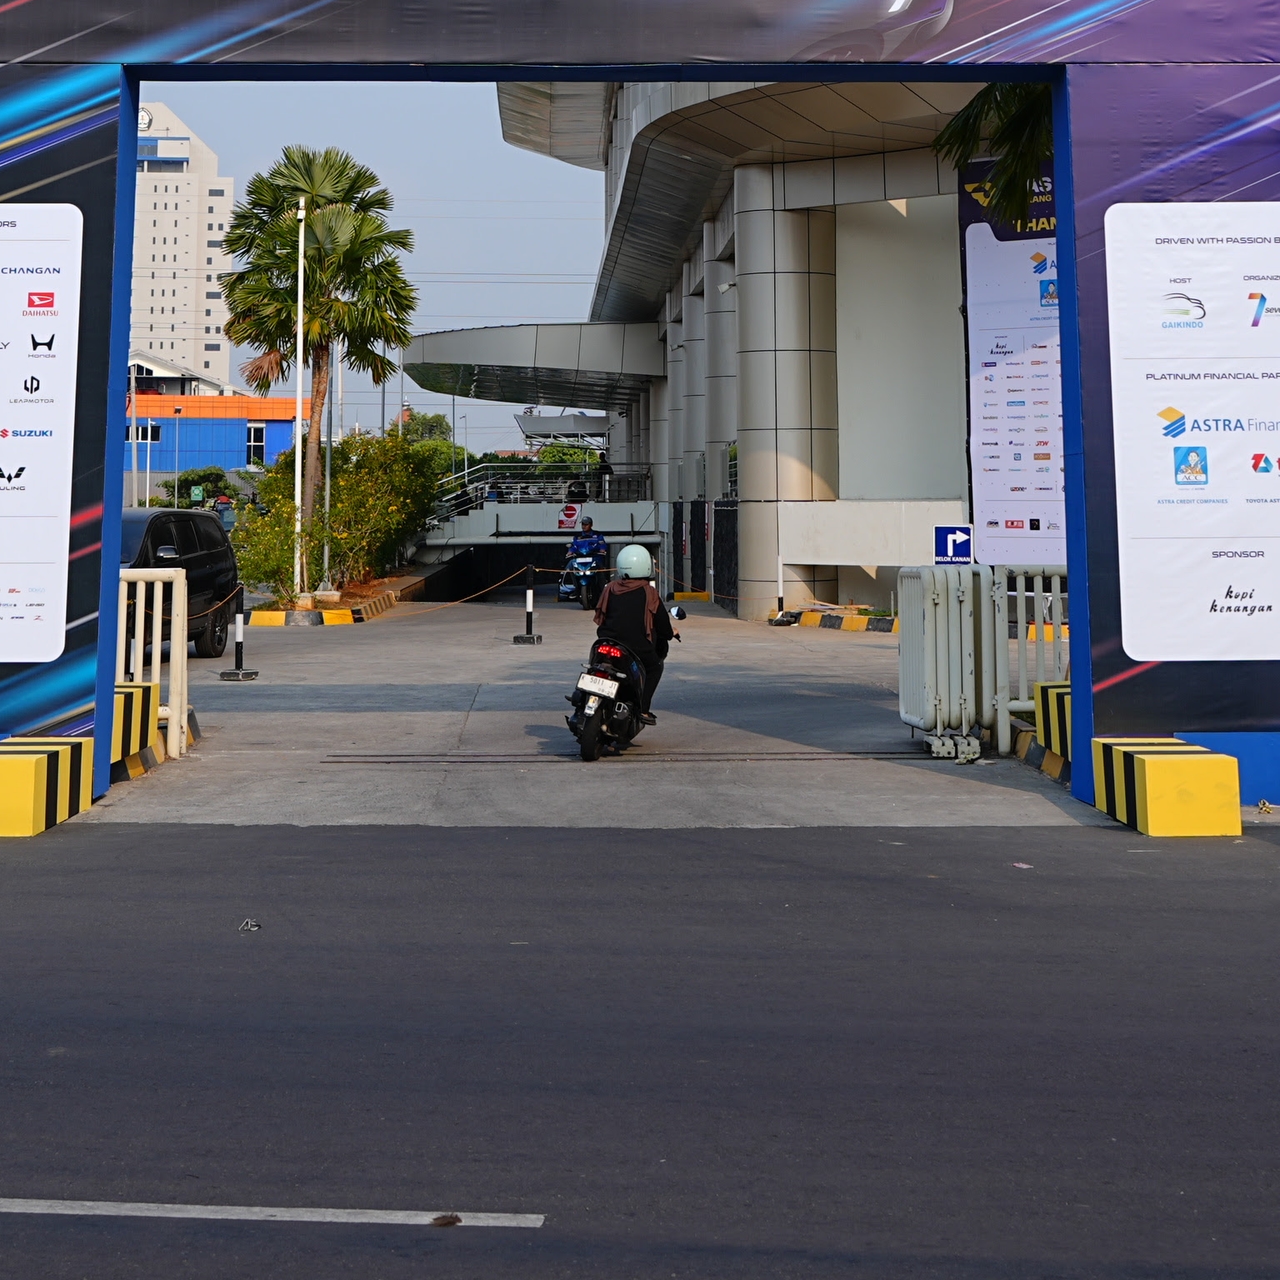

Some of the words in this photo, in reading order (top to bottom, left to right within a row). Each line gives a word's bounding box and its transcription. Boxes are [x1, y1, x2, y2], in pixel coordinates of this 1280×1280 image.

[1155, 237, 1194, 245] DRIVEN
[1161, 321, 1204, 329] GAIKINDO
[1204, 372, 1259, 380] FINANCIAL
[1190, 419, 1245, 432] ASTRA
[1212, 550, 1265, 558] SPONSOR
[1225, 585, 1255, 601] kopi
[1209, 600, 1273, 616] kenangan
